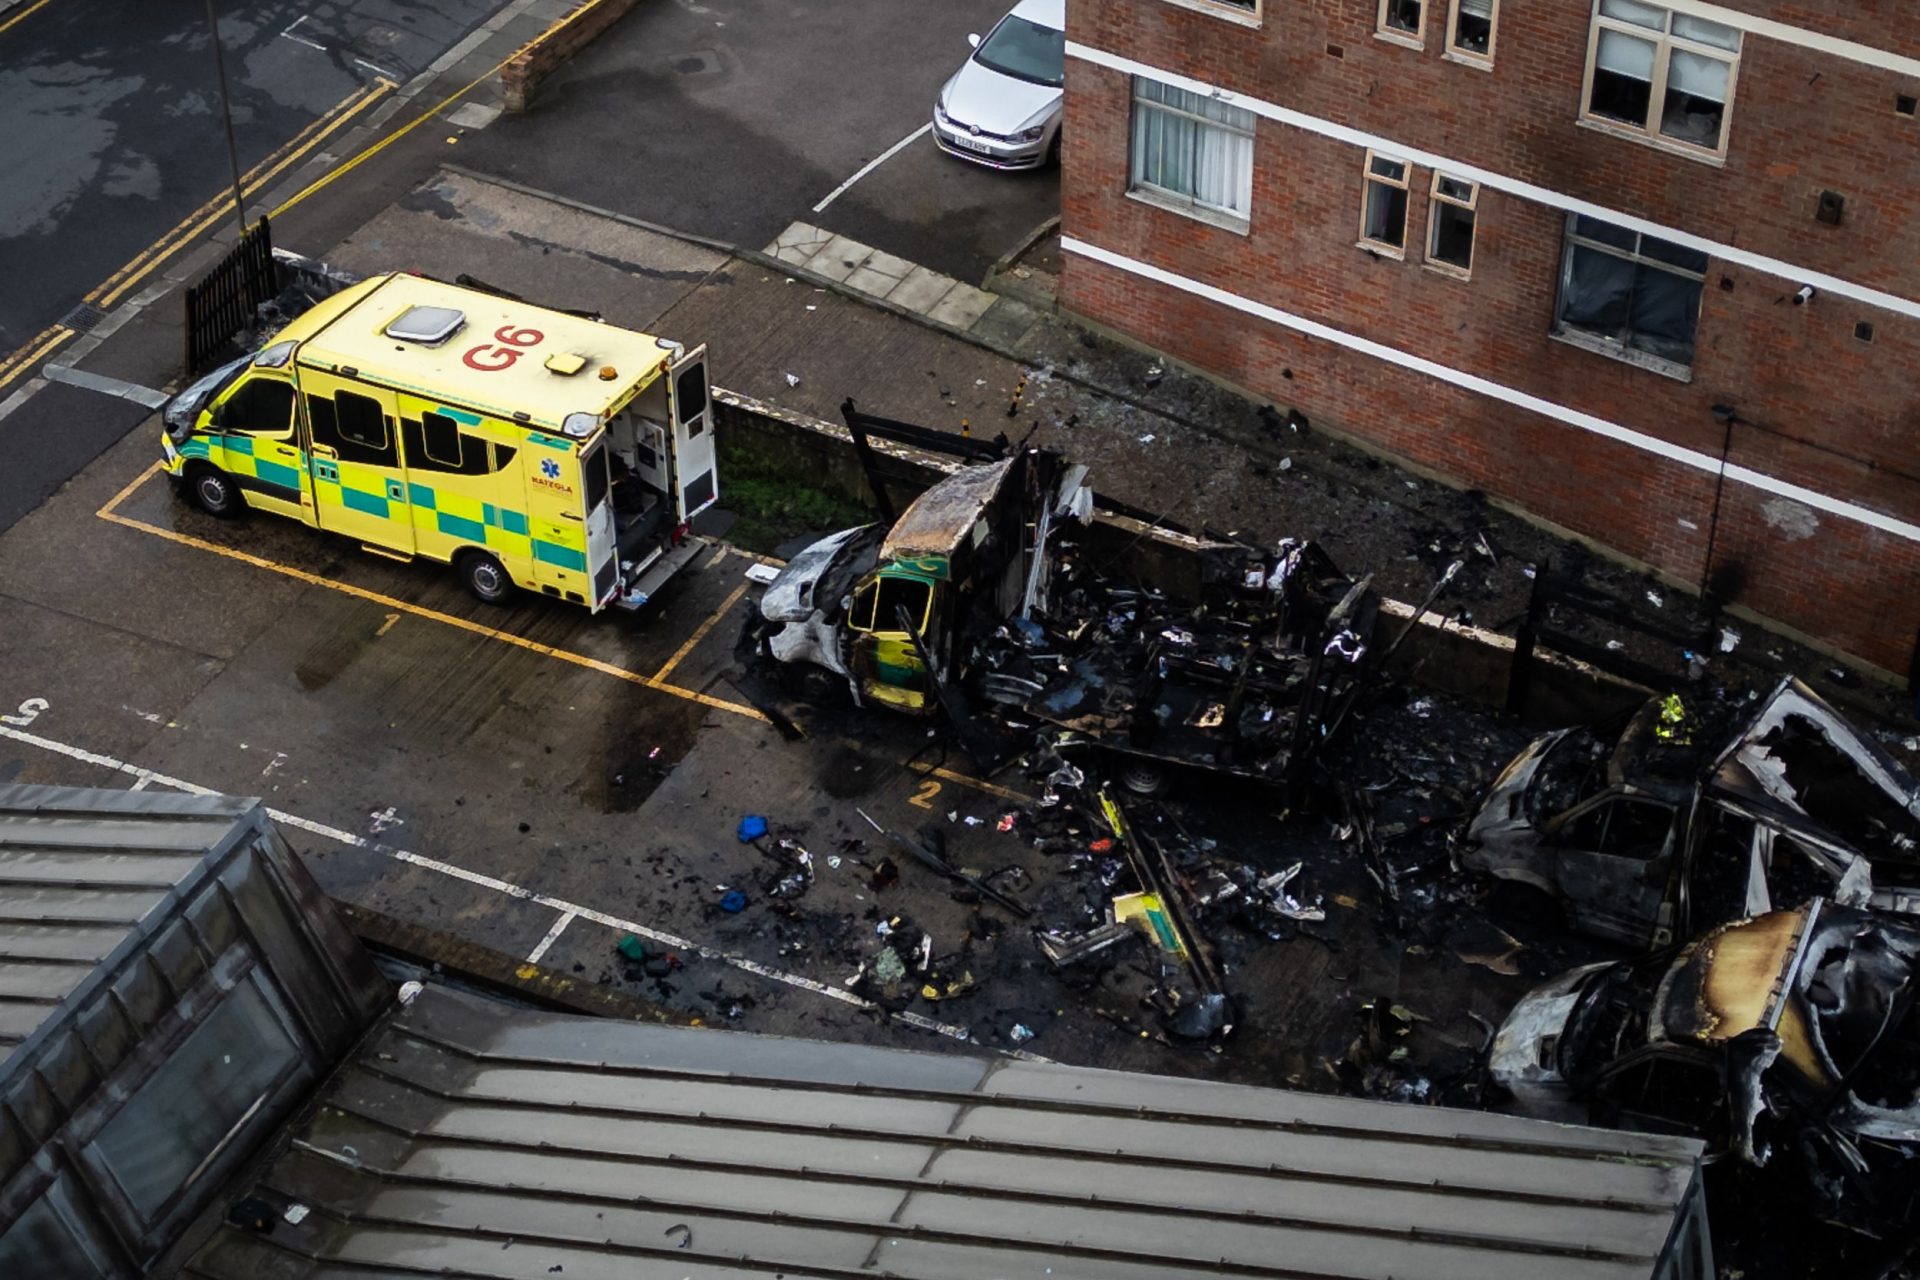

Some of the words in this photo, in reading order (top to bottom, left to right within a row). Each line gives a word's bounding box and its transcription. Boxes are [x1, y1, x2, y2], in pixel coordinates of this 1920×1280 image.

[462, 325, 545, 371] G6
[375, 613, 401, 636] 1
[1, 697, 50, 727] 5
[908, 780, 942, 809] 2
